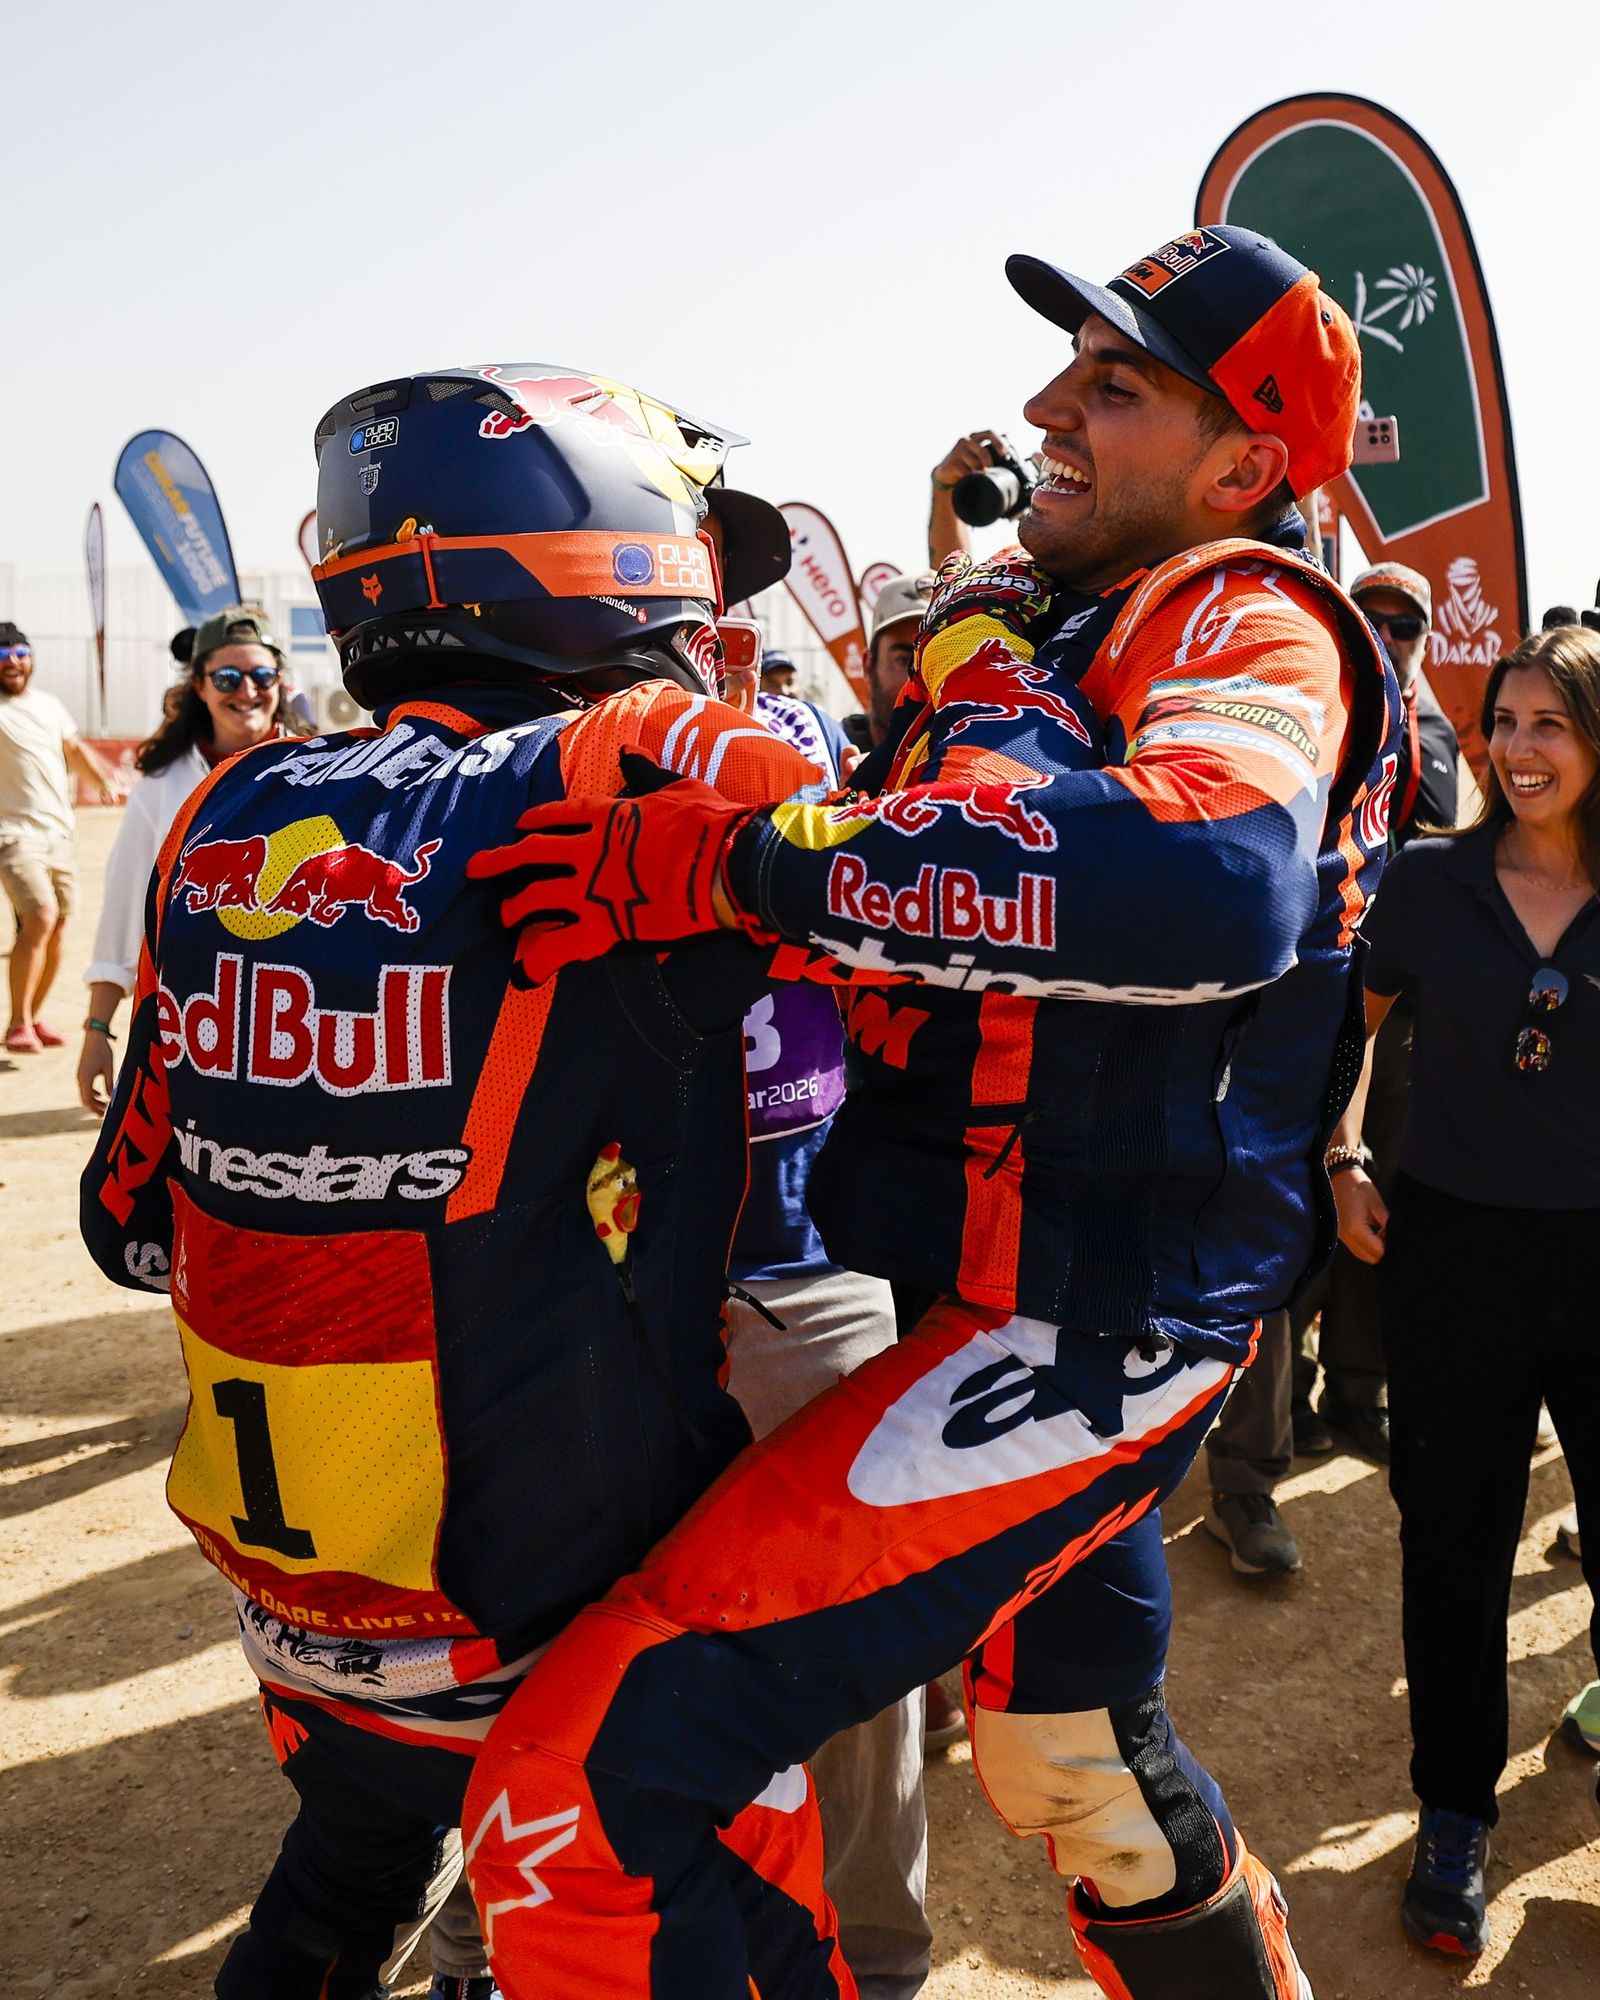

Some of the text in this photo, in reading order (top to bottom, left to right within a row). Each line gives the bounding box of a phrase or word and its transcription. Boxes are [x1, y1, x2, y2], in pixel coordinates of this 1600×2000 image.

[364, 431, 393, 448] LOCK
[366, 421, 395, 438] QUAD
[657, 543, 707, 568] QUA
[659, 565, 710, 590] LOC
[1431, 630, 1502, 668] DAKAR
[212, 1378, 318, 1560] 1
[260, 1587, 339, 1629] DARE.
[342, 1613, 416, 1631] LIVE
